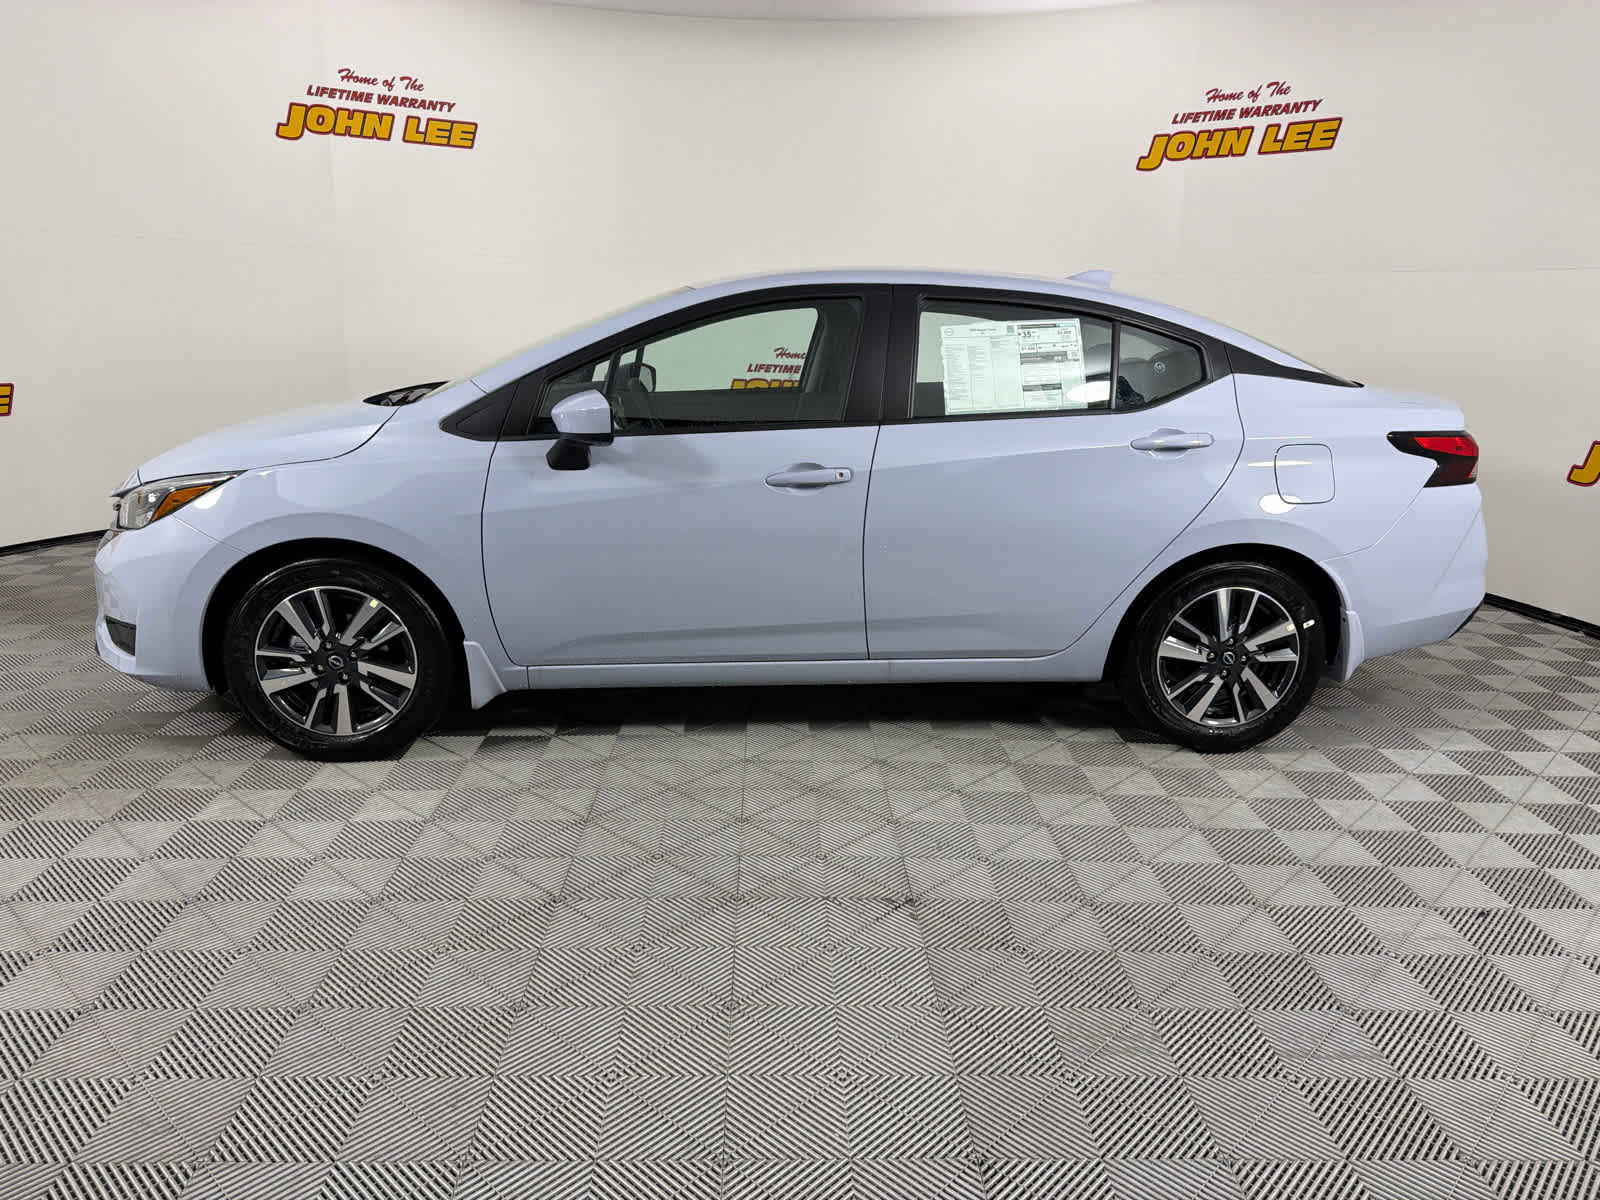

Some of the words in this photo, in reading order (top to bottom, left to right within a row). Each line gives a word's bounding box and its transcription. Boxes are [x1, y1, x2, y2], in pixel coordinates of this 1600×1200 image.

[338, 68, 378, 86] Home
[382, 78, 396, 92] of
[400, 76, 424, 92] The
[1205, 88, 1244, 103] Home
[1247, 85, 1262, 103] of
[1266, 81, 1291, 97] The
[306, 84, 374, 104] LIFETIME
[376, 93, 456, 113] WARRANTY
[1171, 108, 1235, 124] LIFETIME
[1238, 98, 1324, 119] WARRANTY
[276, 102, 395, 141] JOHN
[402, 115, 478, 149] LEE
[1136, 126, 1254, 171] JOHN
[1258, 117, 1343, 155] LEE
[747, 363, 801, 374] LIFETIME
